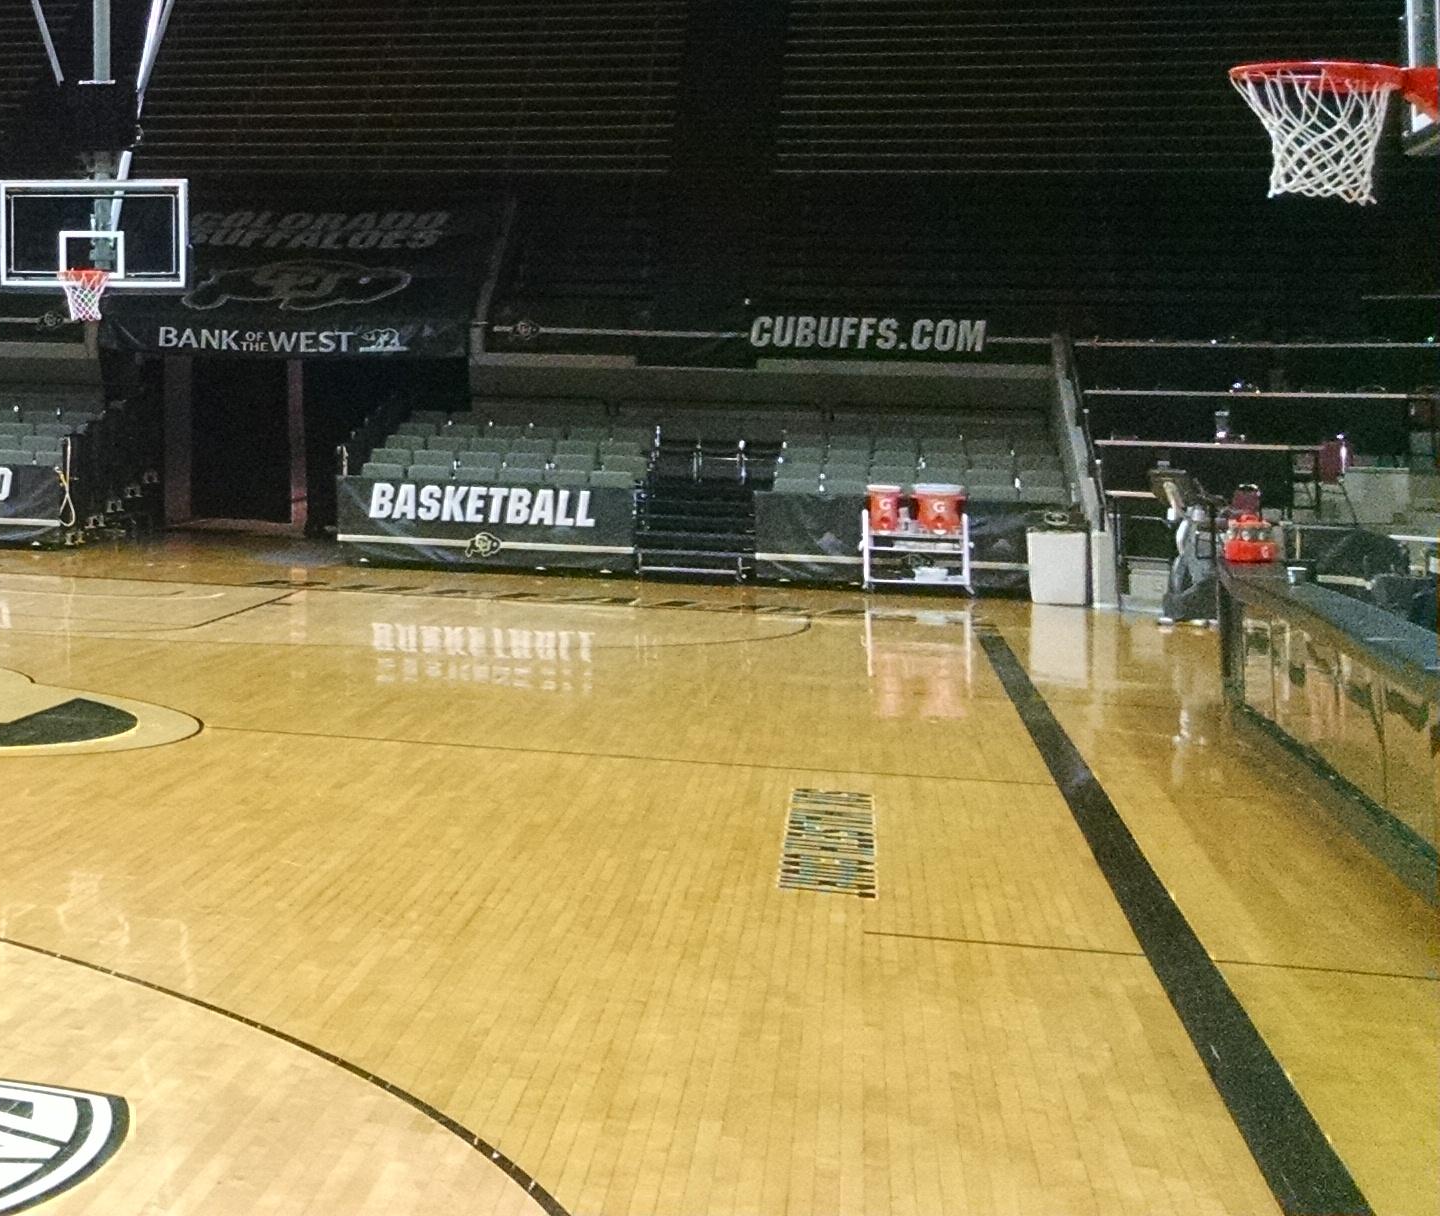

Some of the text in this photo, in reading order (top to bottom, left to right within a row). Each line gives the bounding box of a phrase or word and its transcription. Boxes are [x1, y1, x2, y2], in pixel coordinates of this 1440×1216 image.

[192, 212, 451, 229] COLORADO
[158, 326, 355, 353] BANK OF THE WEST
[750, 316, 987, 352] CUBUFFS.COM
[369, 482, 596, 528] BASKETBALL
[933, 501, 946, 513] G
